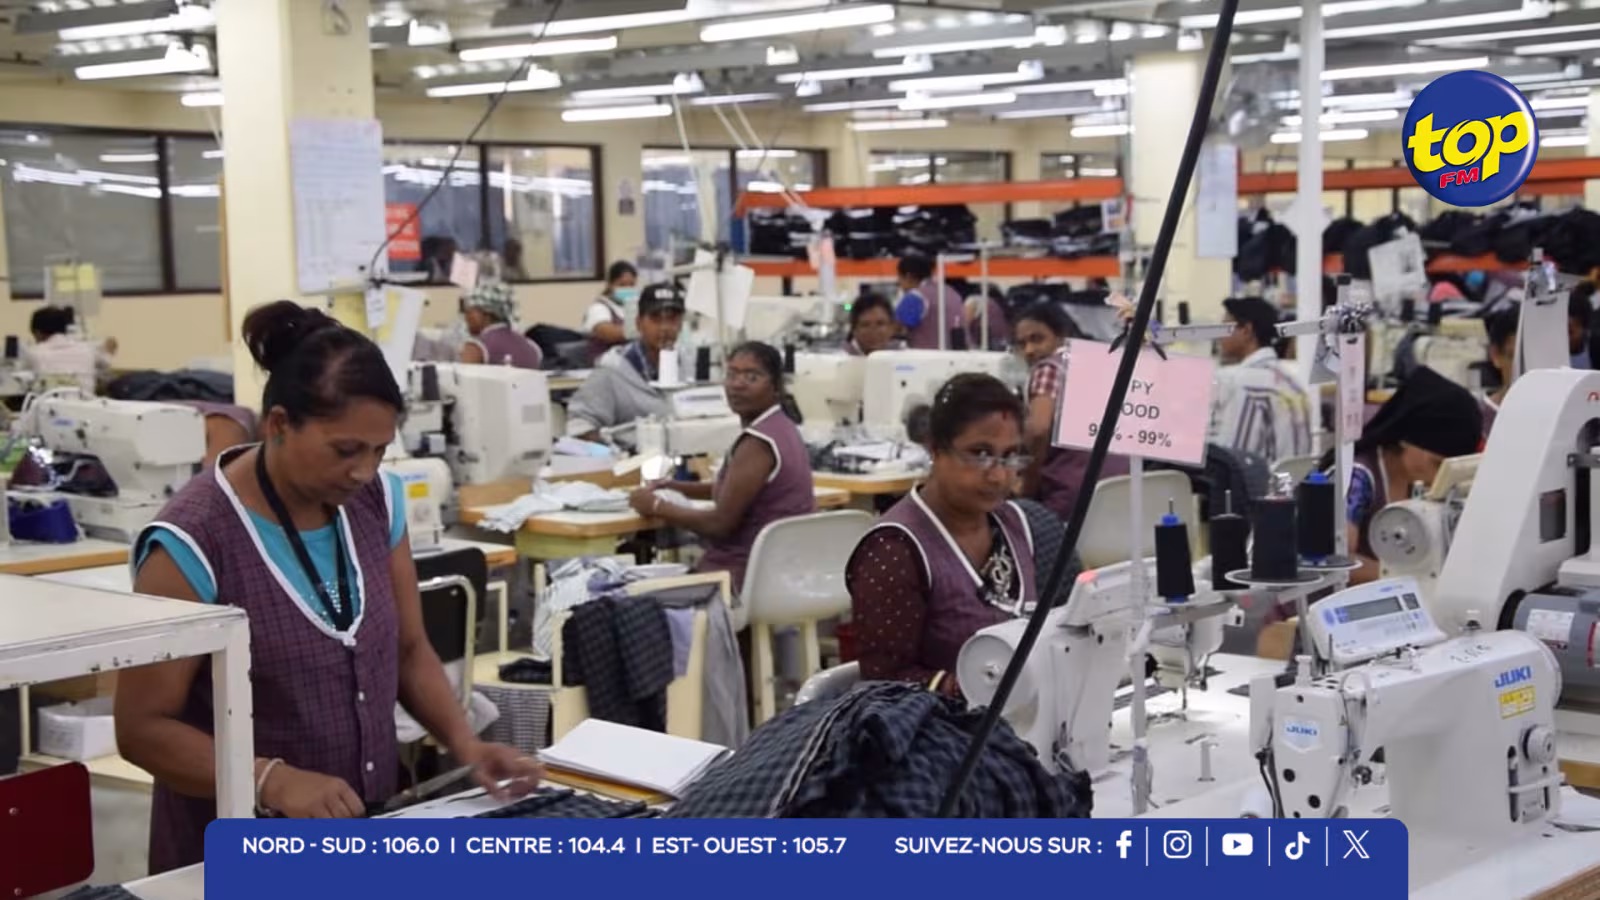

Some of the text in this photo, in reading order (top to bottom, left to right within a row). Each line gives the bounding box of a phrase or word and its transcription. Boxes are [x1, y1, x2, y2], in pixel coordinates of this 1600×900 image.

[1131, 379, 1154, 396] PY
[1120, 402, 1160, 420] OOD
[1138, 430, 1172, 448] 99%
[1495, 665, 1532, 688] JUKI
[1286, 726, 1317, 736] JUKI
